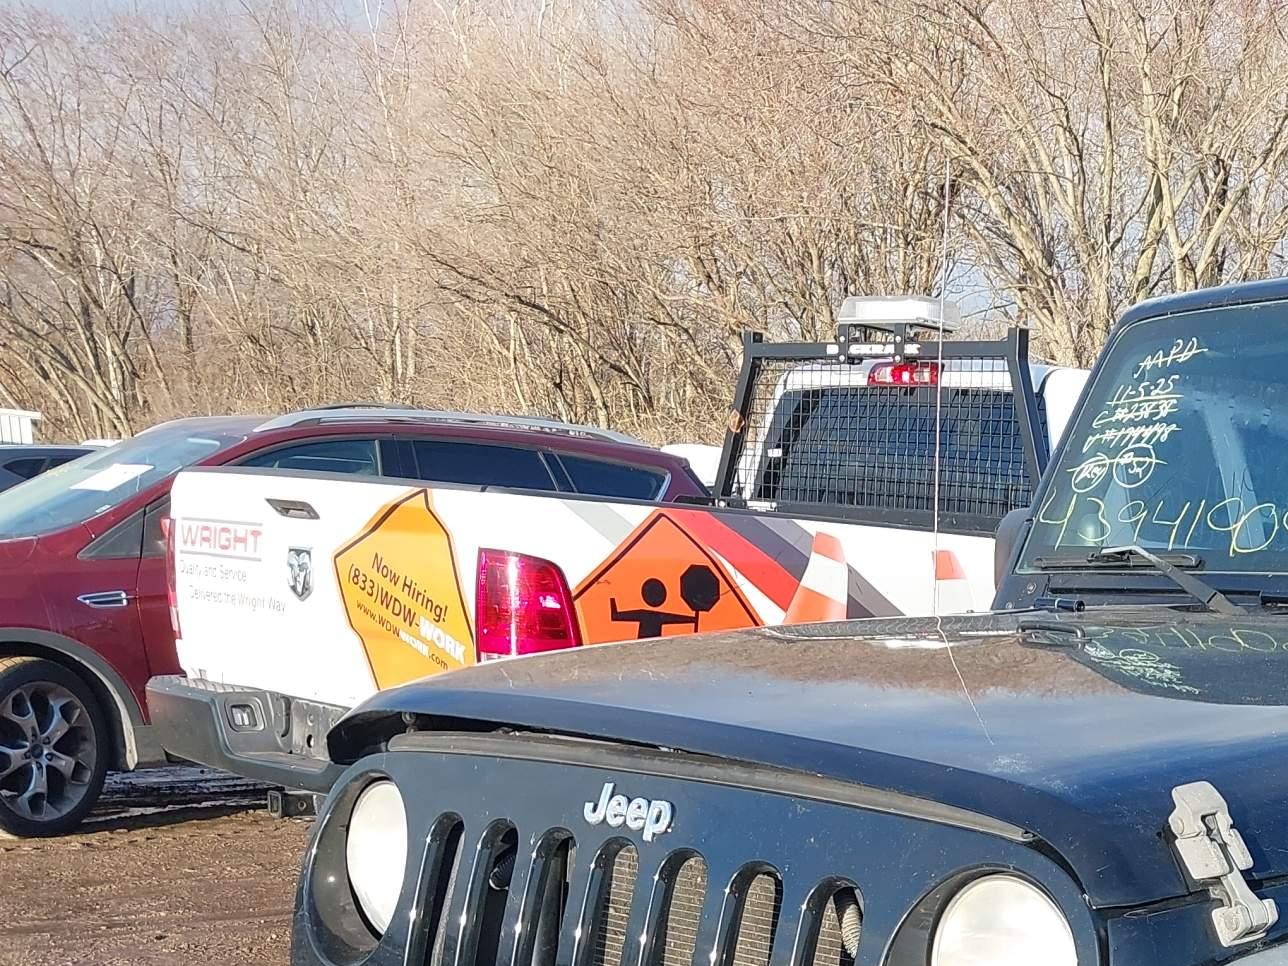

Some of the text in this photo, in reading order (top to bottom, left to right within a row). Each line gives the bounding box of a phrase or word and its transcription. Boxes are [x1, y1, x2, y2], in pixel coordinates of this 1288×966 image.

[181, 523, 263, 553] WRIGHT
[267, 595, 287, 615] Way
[371, 551, 449, 624] Now Hiring!
[583, 782, 673, 842] Jeep
